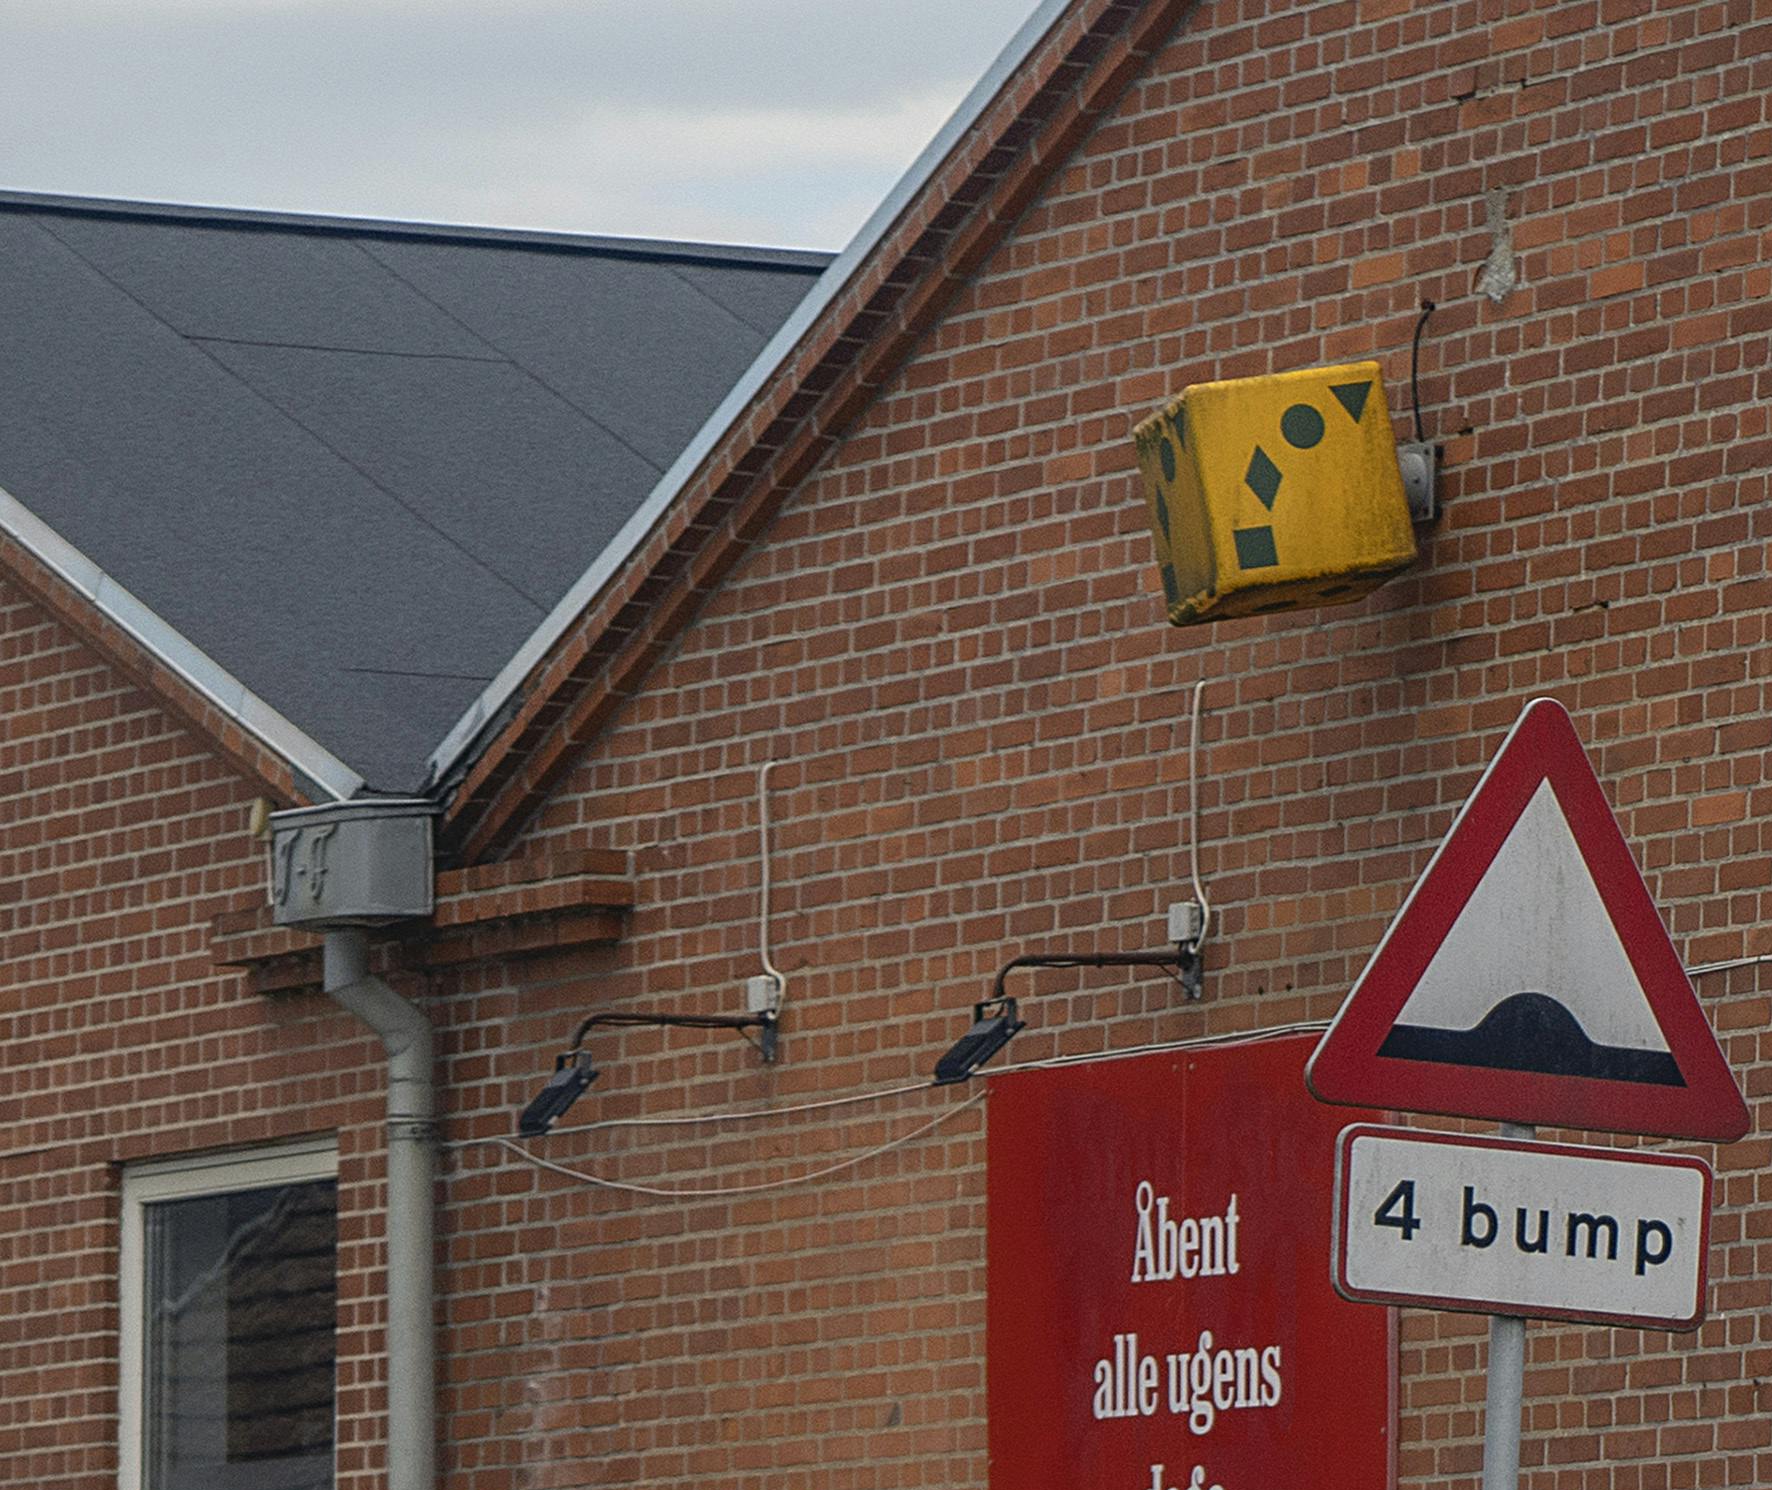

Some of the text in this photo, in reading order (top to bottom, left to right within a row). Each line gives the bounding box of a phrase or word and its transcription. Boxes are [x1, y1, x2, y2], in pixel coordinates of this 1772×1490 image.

[1130, 1180, 1241, 1284] Åbent
[1373, 1180, 1674, 1276] 4 bump
[1092, 1330, 1283, 1436] alle ugens
